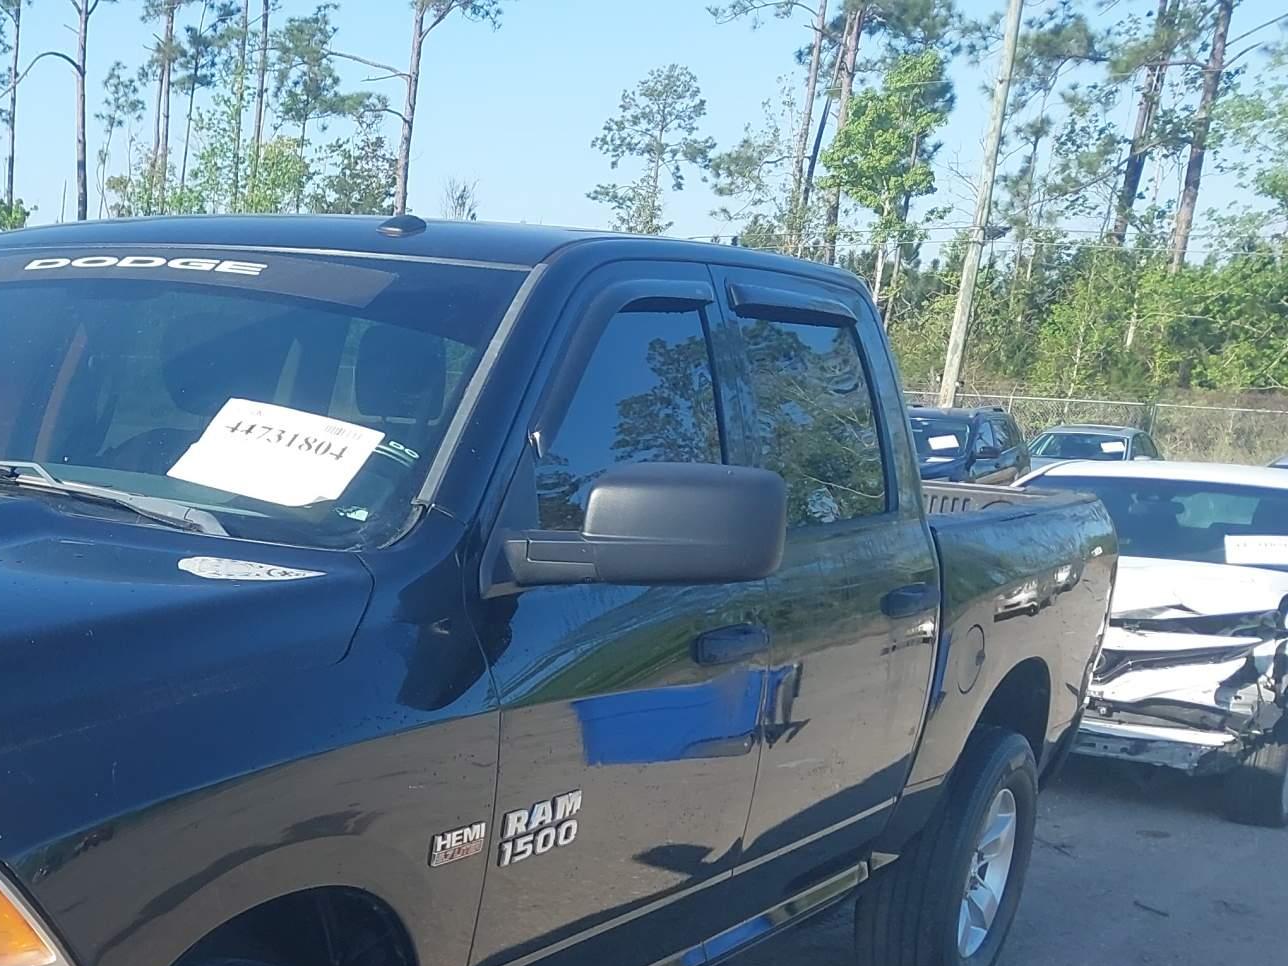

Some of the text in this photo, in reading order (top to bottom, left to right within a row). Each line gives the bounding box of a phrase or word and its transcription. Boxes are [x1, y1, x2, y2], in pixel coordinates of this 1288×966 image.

[24, 256, 268, 275] DODGE
[225, 421, 348, 460] 44731804
[502, 790, 582, 838] RAM
[436, 823, 485, 851] HEMI
[499, 819, 578, 867] 1500
